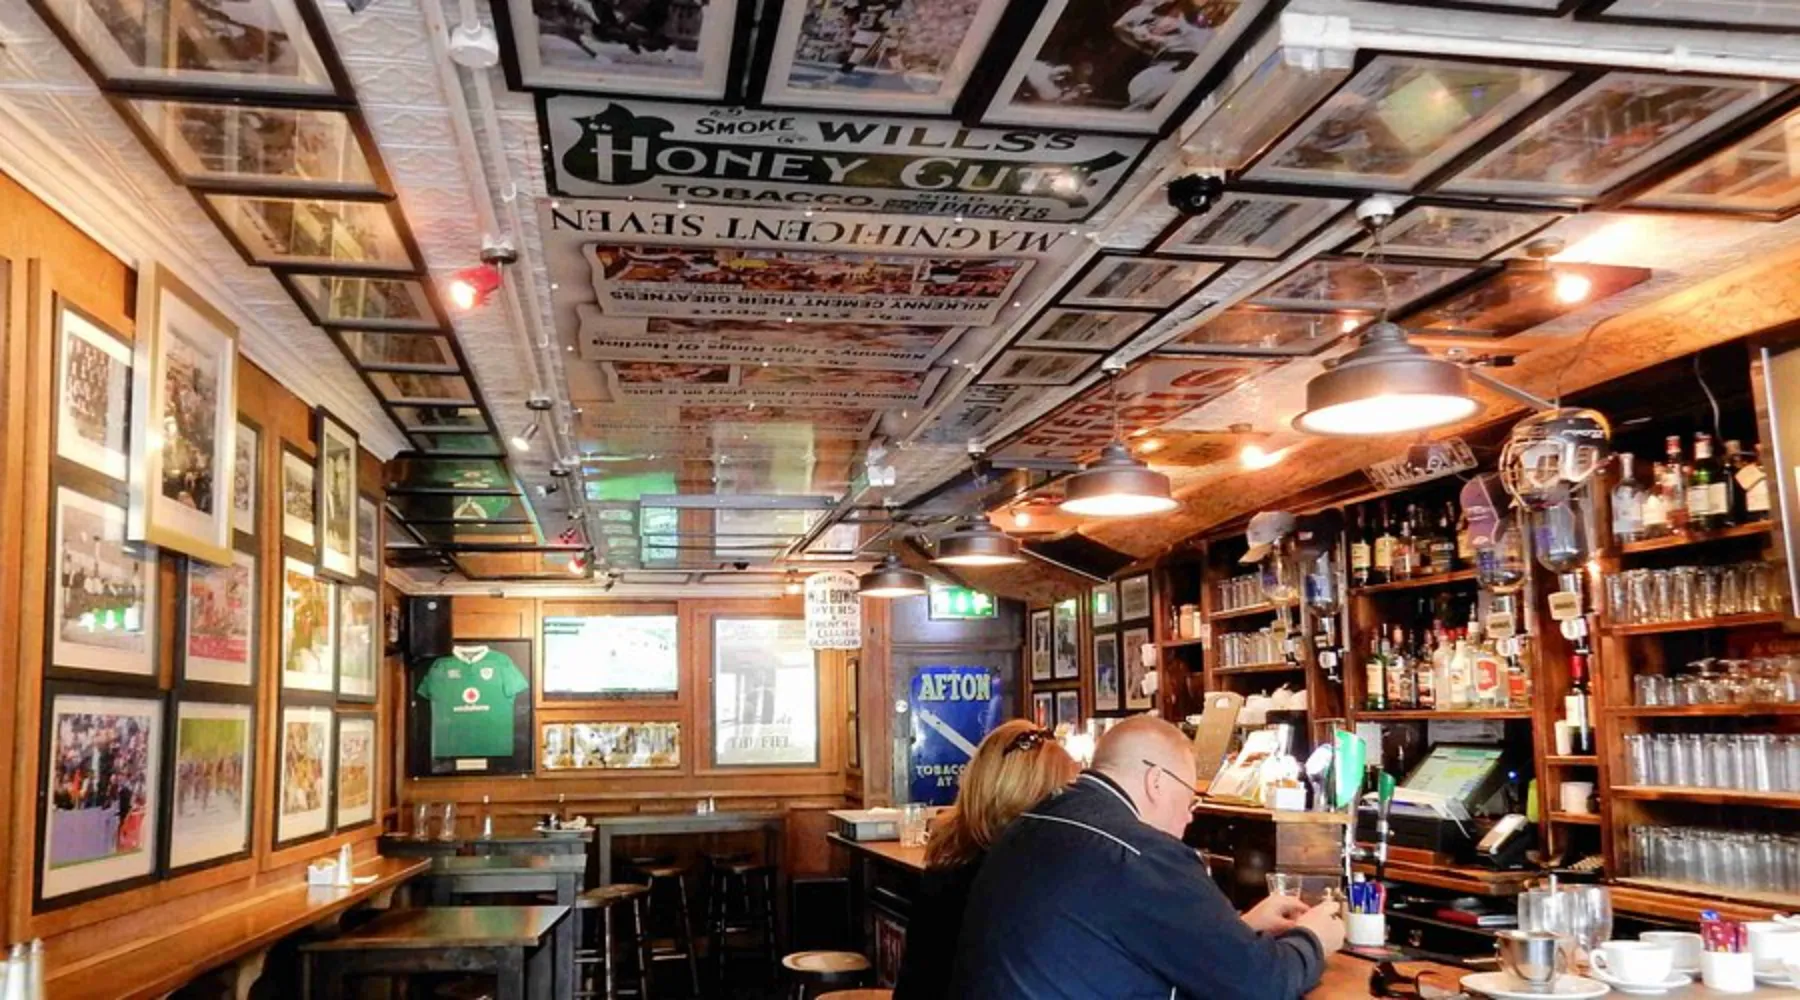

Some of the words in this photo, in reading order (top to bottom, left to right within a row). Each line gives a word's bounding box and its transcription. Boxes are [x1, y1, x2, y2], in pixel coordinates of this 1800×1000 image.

[695, 117, 796, 136] SMOKE
[590, 132, 868, 183] HONEY
[900, 156, 1064, 195] CUT
[939, 202, 1051, 219] PACKETS
[551, 209, 705, 237] SEVEN
[715, 217, 1065, 253] MAGNIFICENT
[610, 291, 731, 304] GREATNESS
[737, 296, 794, 306] THEIR
[803, 300, 884, 310] CEMENT
[891, 301, 989, 311] KILKENNY
[918, 672, 991, 701] AFTON
[916, 764, 967, 776] TOBACC
